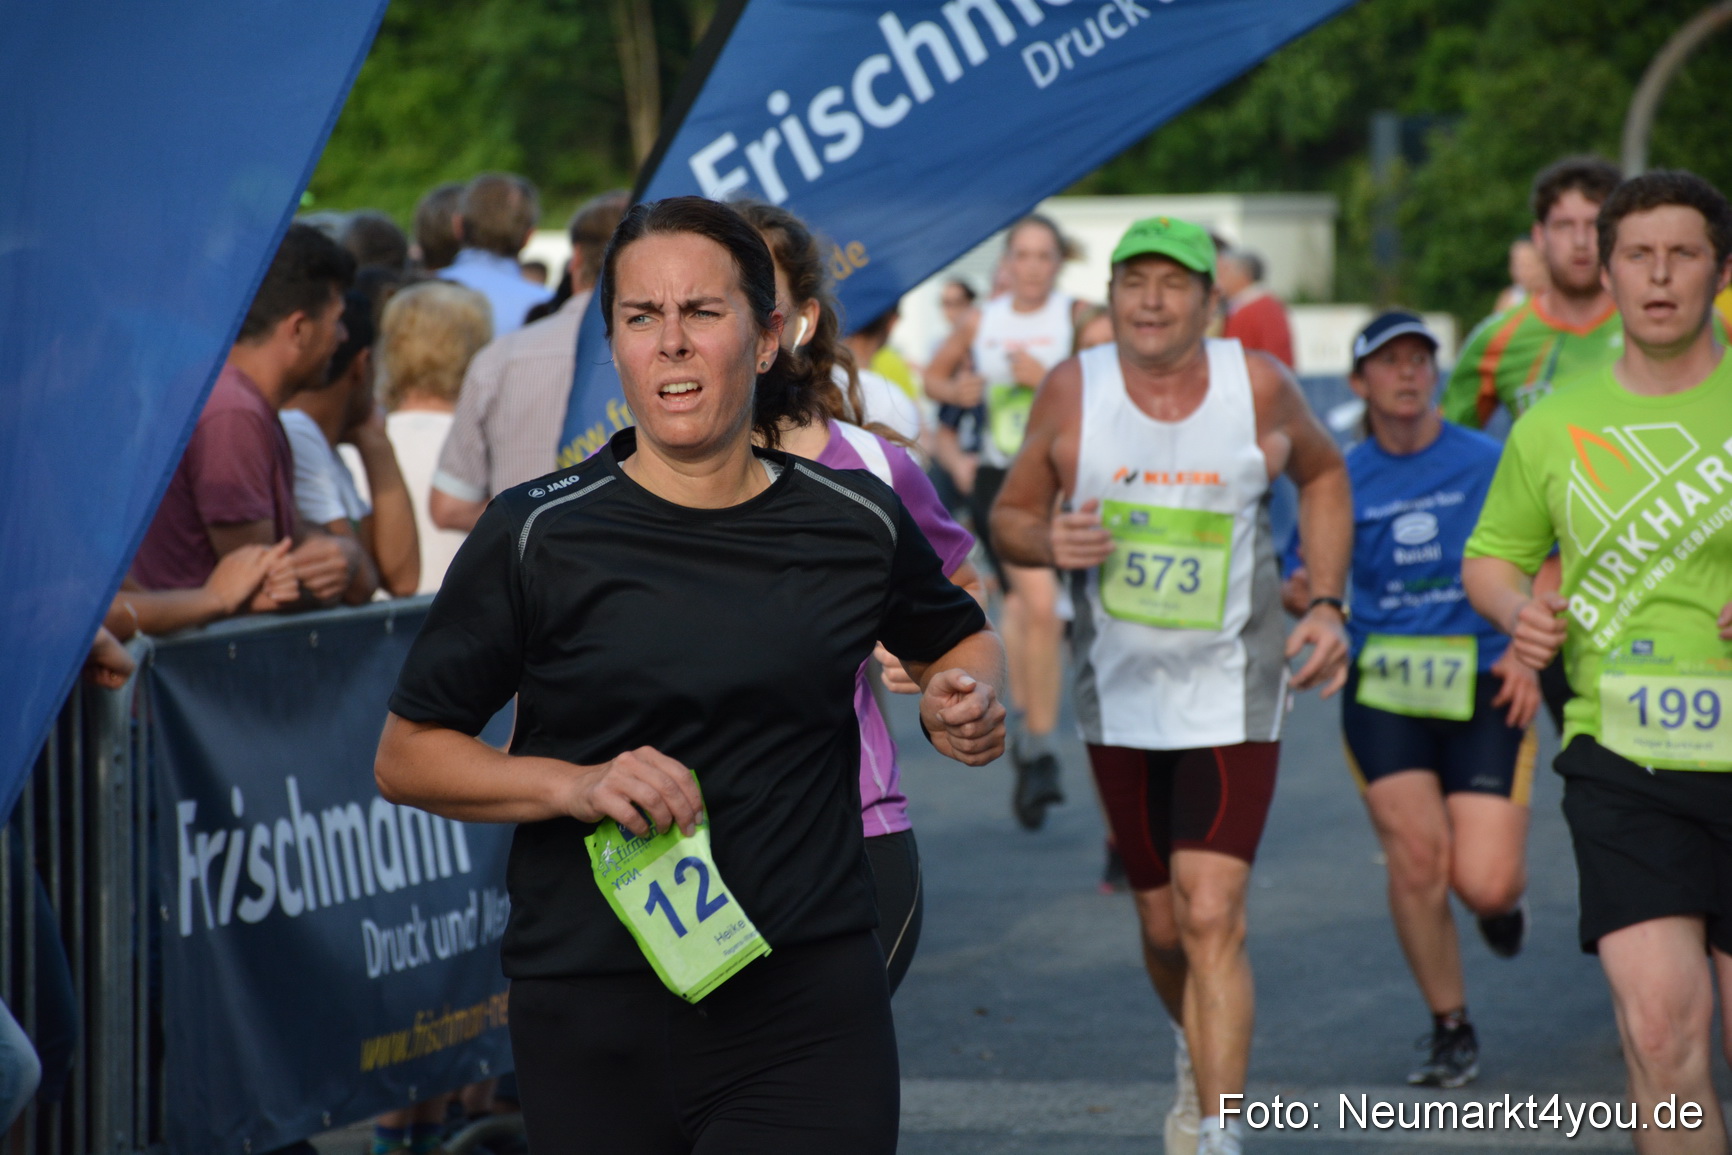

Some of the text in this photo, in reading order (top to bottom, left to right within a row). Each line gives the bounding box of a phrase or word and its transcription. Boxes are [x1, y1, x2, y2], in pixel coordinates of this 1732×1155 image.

[1021, 0, 1151, 89] Druck
[688, 0, 1073, 206] Frischm
[546, 475, 580, 493] JAKO
[1567, 436, 1732, 632] BURKHAR
[1672, 498, 1732, 561] GEBÄUD
[1124, 551, 1202, 595] 573
[1373, 652, 1465, 689] 1117
[1628, 685, 1722, 732] 199
[176, 775, 472, 938] Frischmann
[361, 903, 431, 979] Druck
[431, 888, 477, 960] und
[643, 855, 730, 939] 12
[713, 919, 746, 946] Heike
